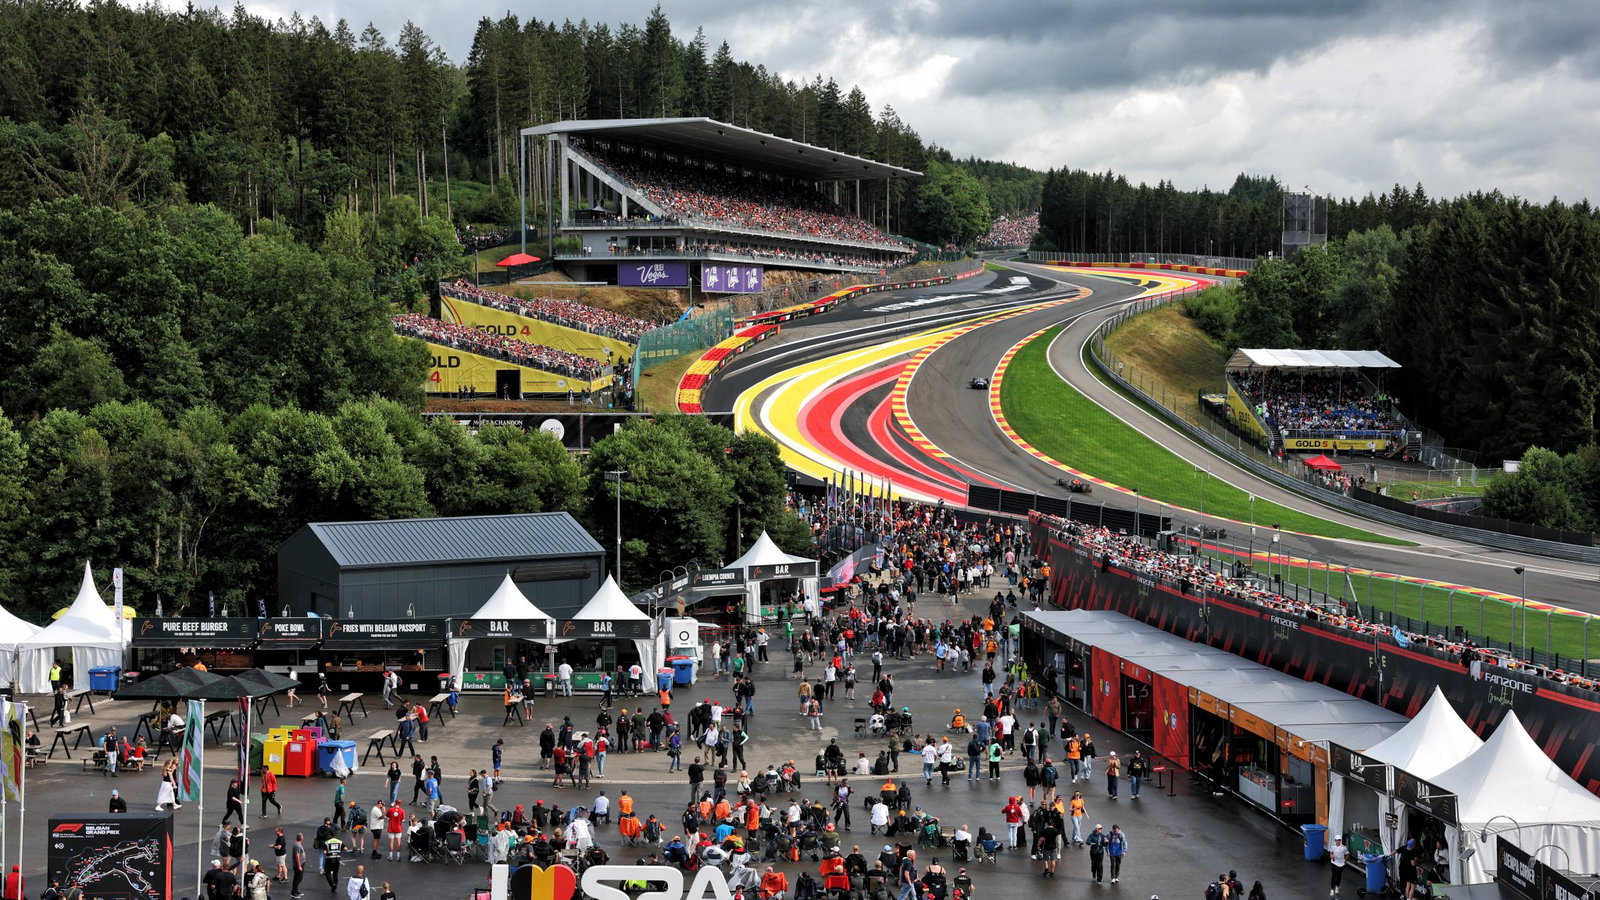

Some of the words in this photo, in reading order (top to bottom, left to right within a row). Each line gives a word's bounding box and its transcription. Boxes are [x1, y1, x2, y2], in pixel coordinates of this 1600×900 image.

[637, 265, 669, 284] Vegas
[520, 325, 531, 336] 4
[429, 371, 442, 383] 4
[1295, 440, 1321, 448] GOLD
[775, 565, 789, 574] BAR
[719, 572, 735, 580] CORNER
[162, 622, 181, 632] PURE
[182, 622, 200, 632] BEEF
[200, 622, 228, 632] BURGER
[274, 623, 289, 632] POKE
[289, 623, 305, 632] BOWL
[342, 624, 359, 633] FRIES
[359, 624, 374, 633] WITH
[374, 623, 398, 633] BELGIAN
[398, 623, 427, 632] PASSPORT
[490, 620, 509, 632] BAR
[593, 621, 613, 632] BAR
[1270, 615, 1299, 630] FANZONE
[1381, 655, 1387, 668] E
[1484, 672, 1533, 694] FANZONE
[1416, 781, 1431, 804] BAR
